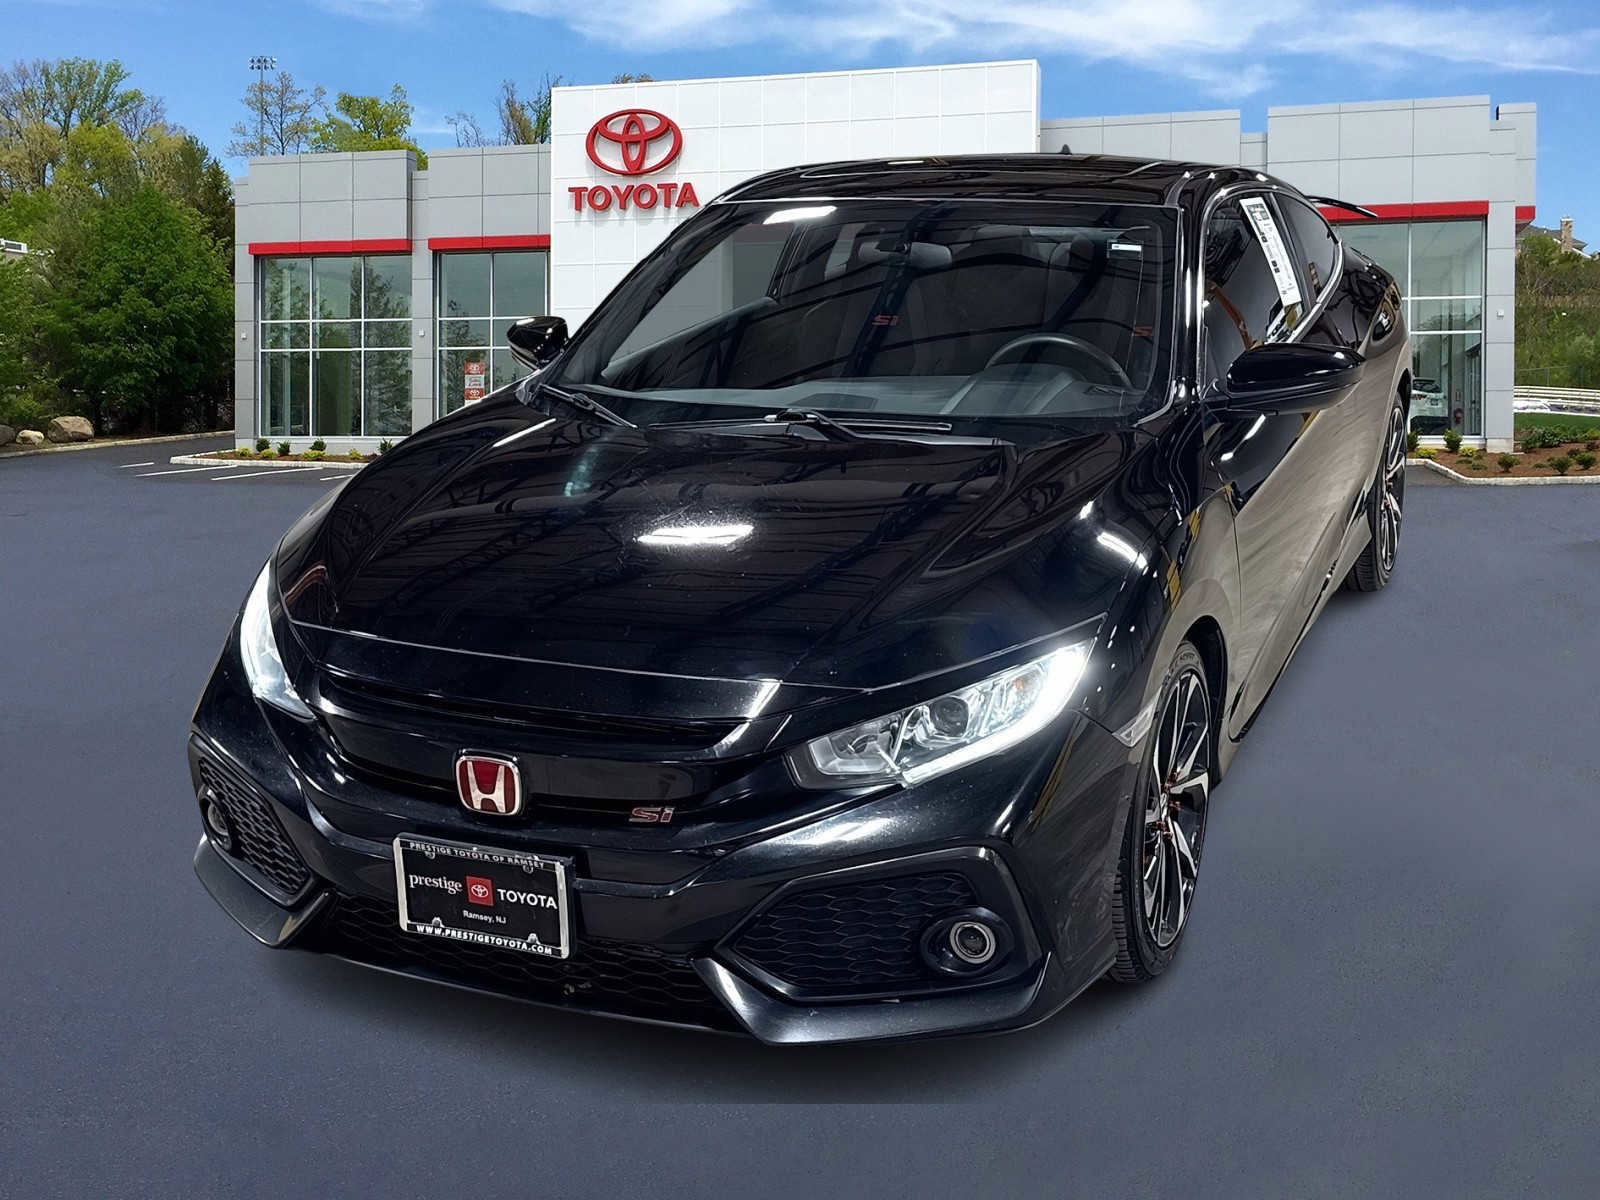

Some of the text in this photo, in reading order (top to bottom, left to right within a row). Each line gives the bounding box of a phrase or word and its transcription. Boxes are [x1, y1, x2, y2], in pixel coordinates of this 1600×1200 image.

[568, 183, 700, 212] TOYOTA
[629, 807, 674, 823] Si
[409, 842, 451, 855] PRESTIGE
[454, 849, 489, 861] TOYOTA
[508, 858, 544, 869] RAMSEY
[409, 874, 462, 894] prestige
[497, 889, 558, 909] TOYOTA
[462, 910, 506, 924] Ramsey, NJ
[416, 925, 552, 954] WWW.PRESTIGETOYOTA.COM
